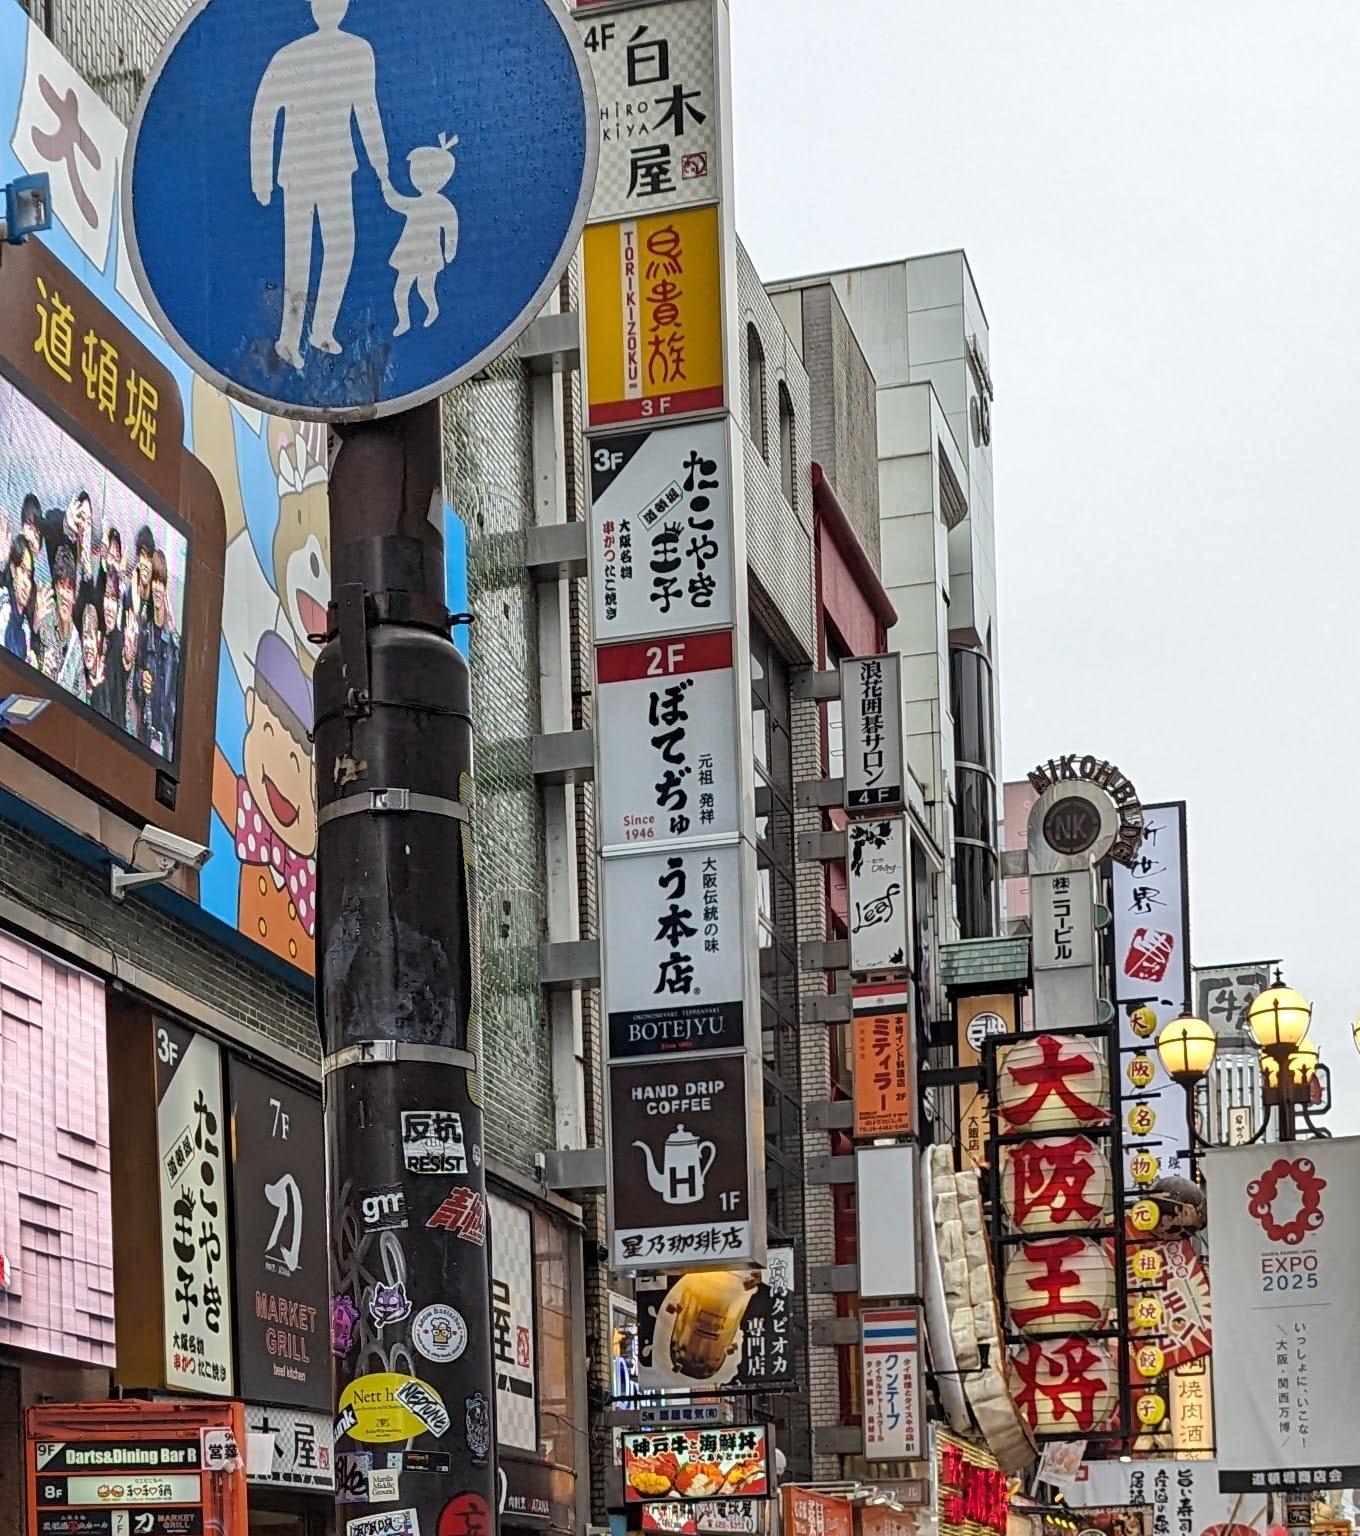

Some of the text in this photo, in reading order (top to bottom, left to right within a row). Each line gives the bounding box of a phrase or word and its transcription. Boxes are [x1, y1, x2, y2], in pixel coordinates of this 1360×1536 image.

[584, 23, 616, 52] 4F
[600, 101, 648, 119] HIRO
[626, 25, 706, 198] 白木屋
[603, 122, 649, 141] KIYA
[624, 231, 638, 381] TORIKIZOKU
[646, 225, 686, 384] 鳥貴族
[34, 277, 158, 460] 道頓堀
[641, 398, 672, 417] 3F
[593, 449, 624, 472] 3F
[683, 449, 719, 607] たこやき
[649, 521, 685, 613] 王子
[646, 643, 686, 675] 2F
[623, 814, 656, 827] Since
[625, 827, 655, 841] 1946
[702, 857, 720, 954] 大阪伝統の味
[852, 883, 901, 934] Leaf
[628, 1016, 724, 1041] BOTEJYU
[157, 1028, 179, 1066] 3F
[872, 1018, 892, 1111] ミティラー
[631, 1080, 725, 1100] HAND DRIP
[646, 1097, 712, 1115] COFFEE
[269, 1097, 290, 1140] 7F
[404, 1113, 462, 1143] 反抗
[407, 1156, 464, 1172] RESIST
[194, 1089, 221, 1334] たこやき
[719, 1191, 741, 1212] 1F
[621, 1227, 744, 1260] 星乃珈琲店
[997, 1035, 1113, 1431] 大阪王将
[173, 1184, 198, 1325] 王子
[1261, 1256, 1318, 1274] EXPO
[1263, 1274, 1318, 1291] 2025
[255, 1290, 317, 1334] MARKET
[770, 1258, 789, 1375] 台湾タピオカ
[266, 1327, 310, 1363] GRILL
[747, 1317, 766, 1377] 専門店
[353, 1390, 382, 1404] Nett
[885, 1354, 900, 1431] クンテープ
[1276, 1340, 1290, 1433] 大阪・関西万博
[38, 1444, 56, 1456] 9F
[66, 1448, 197, 1465] Darts&Dining Bar R
[632, 1431, 757, 1458] 神戸牛と海鮮丼
[44, 1485, 63, 1498] 8F
